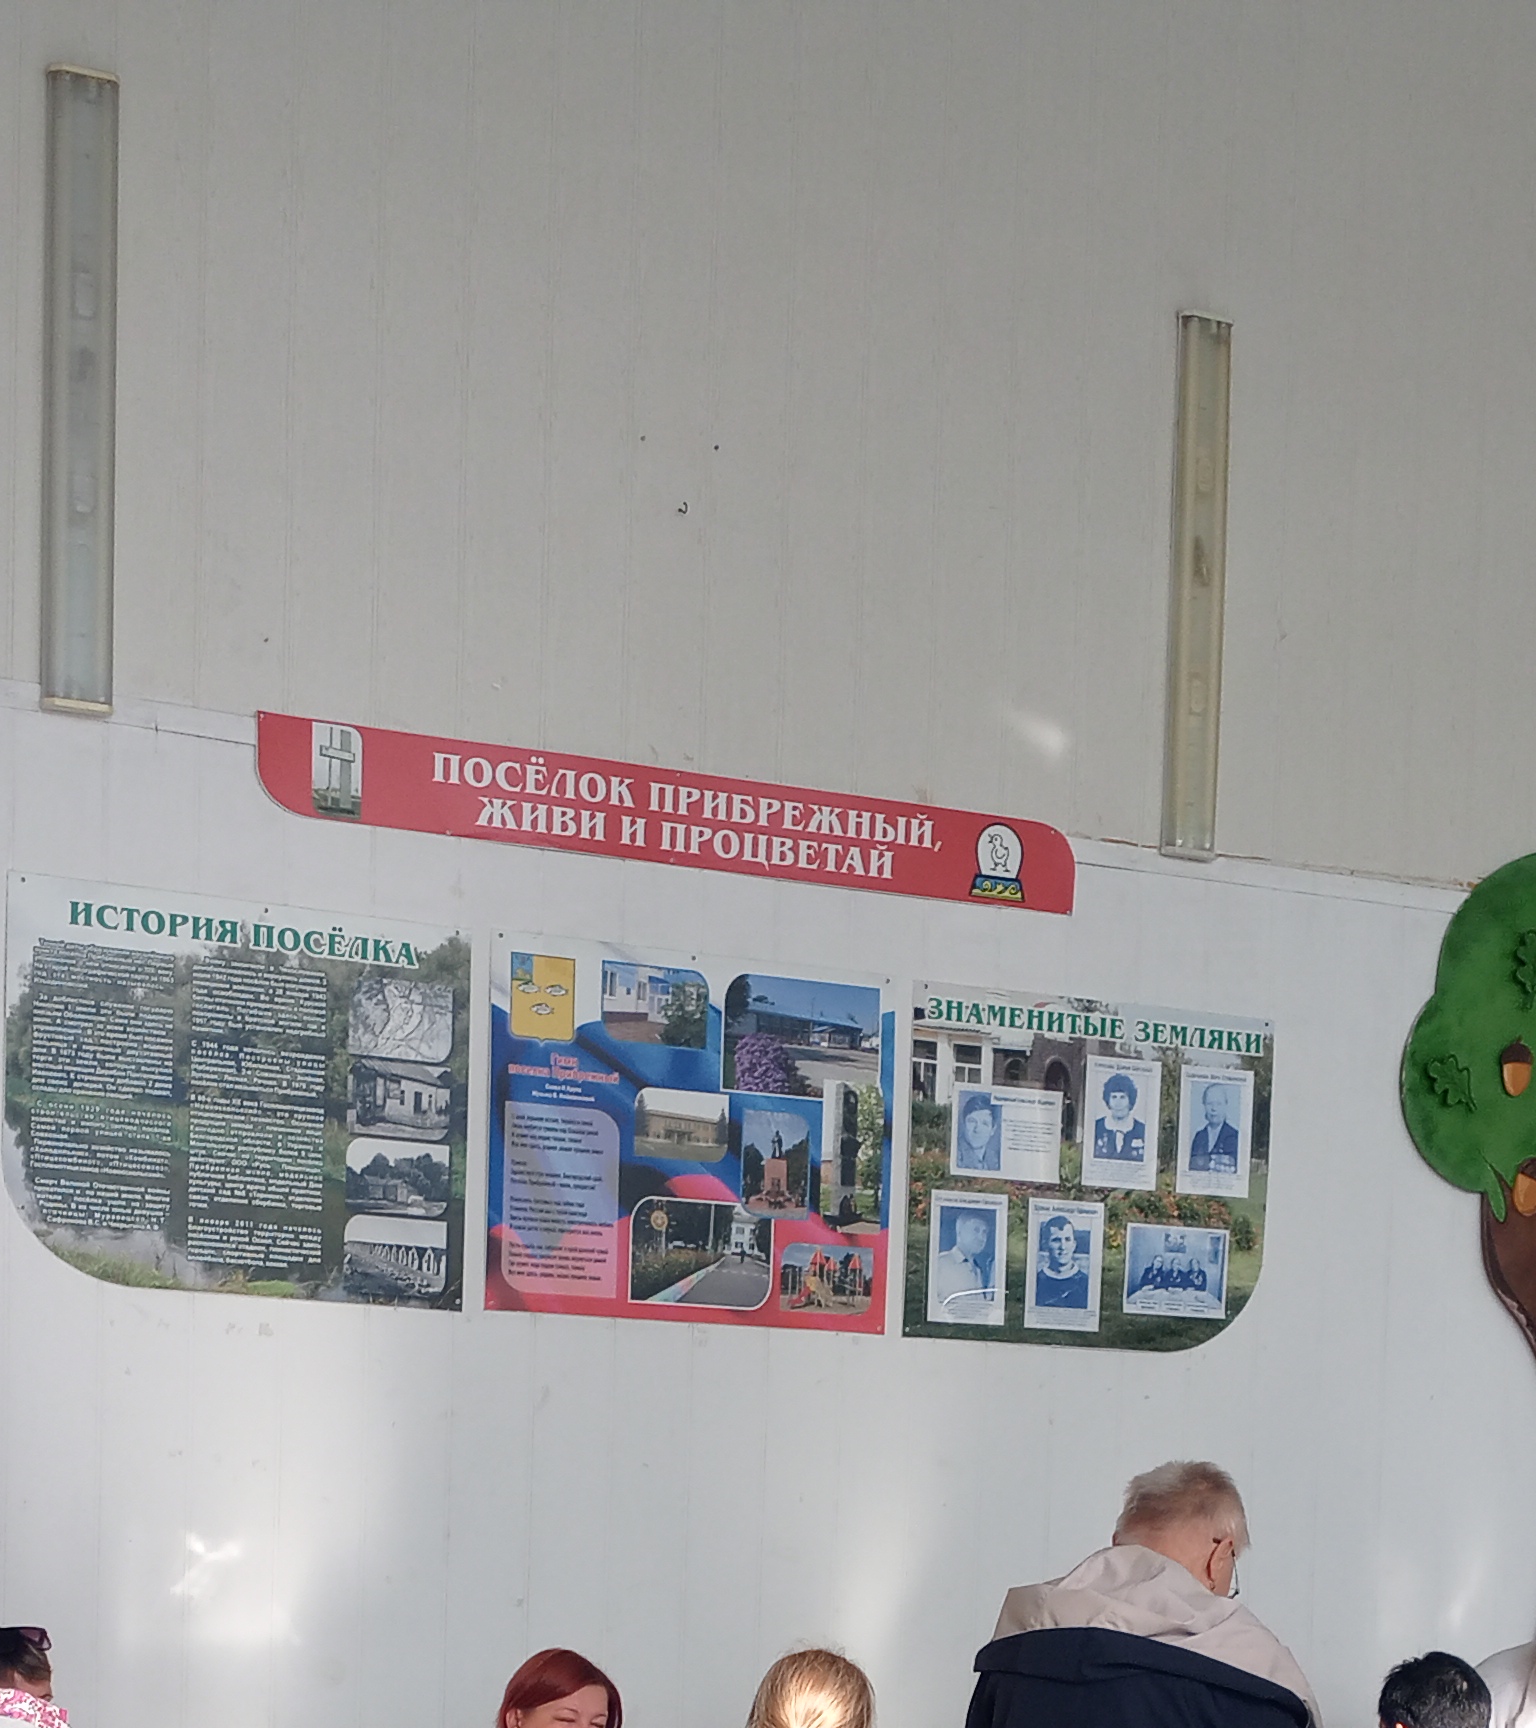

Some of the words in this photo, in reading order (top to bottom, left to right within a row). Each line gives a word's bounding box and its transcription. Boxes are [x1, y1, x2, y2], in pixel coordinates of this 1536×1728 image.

[432, 750, 635, 809] ПОСЁЛОК
[648, 781, 944, 853] ПРИБРЕЖНЫЙ,
[474, 796, 608, 844] ЖИВИ
[620, 816, 646, 848] И
[660, 821, 895, 881] ПРОЦВЕТАЙ
[68, 900, 239, 945] ИСТОРИЯ
[253, 924, 419, 968] ПОСЁЛКА
[926, 997, 1125, 1040] ЗНАМЕНИТЫЕ
[1134, 1020, 1265, 1055] ЗЕМЛЯКИ
